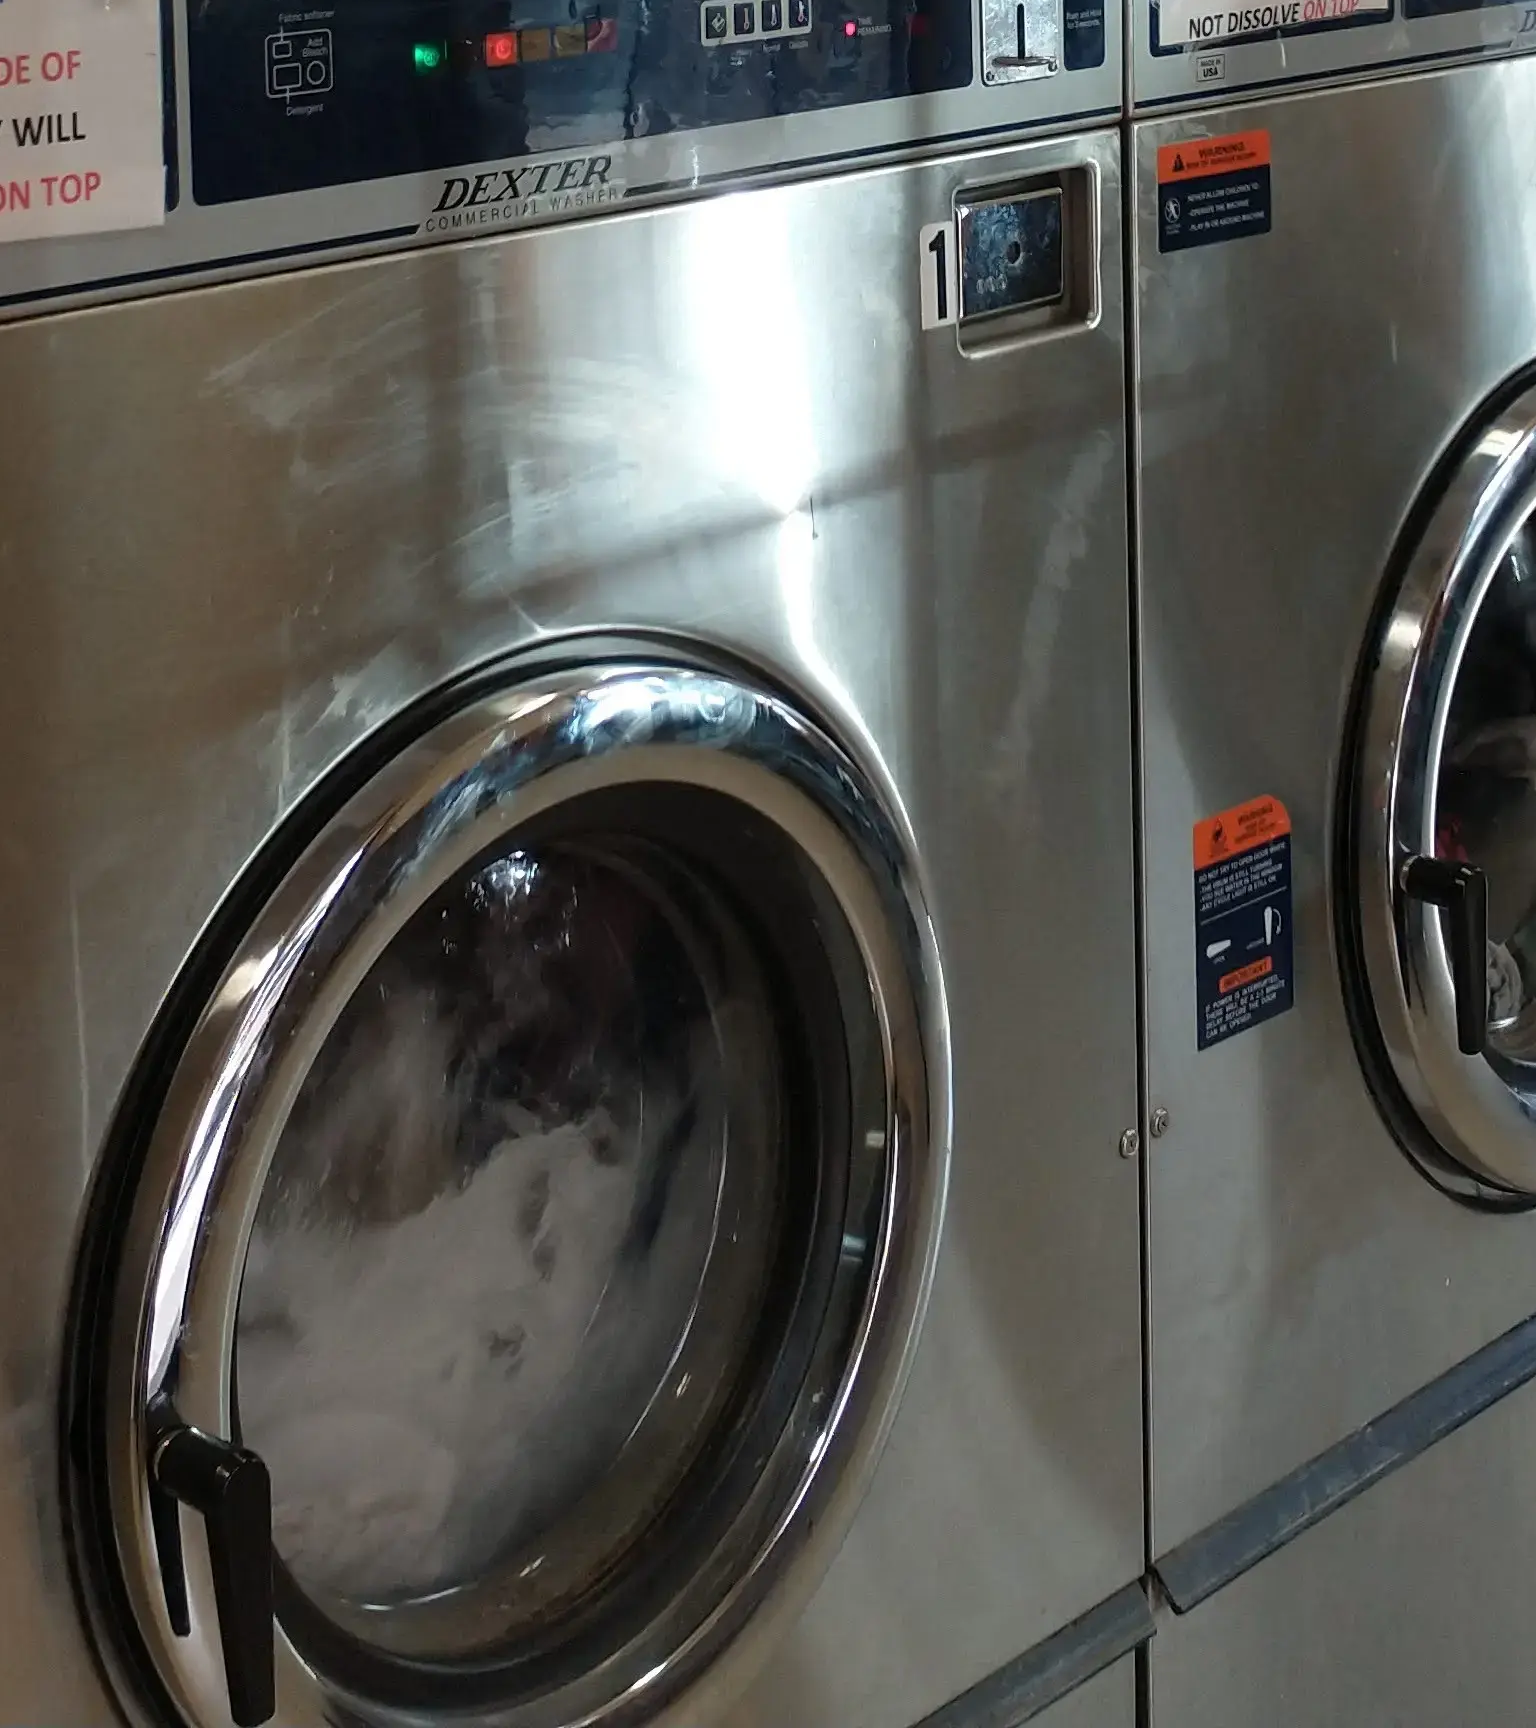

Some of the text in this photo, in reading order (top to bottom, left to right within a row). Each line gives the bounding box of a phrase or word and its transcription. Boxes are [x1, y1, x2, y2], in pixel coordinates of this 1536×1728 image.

[1189, 14, 1224, 40] NOT
[1227, 2, 1301, 33] DISSOLVE
[40, 50, 82, 82] OF
[1202, 67, 1219, 78] USA
[12, 112, 87, 147] WILL
[40, 171, 102, 207] TOP
[431, 154, 612, 213] DEXTER
[425, 188, 618, 233] COMMERCIAL WASHER
[928, 229, 948, 320] 1
